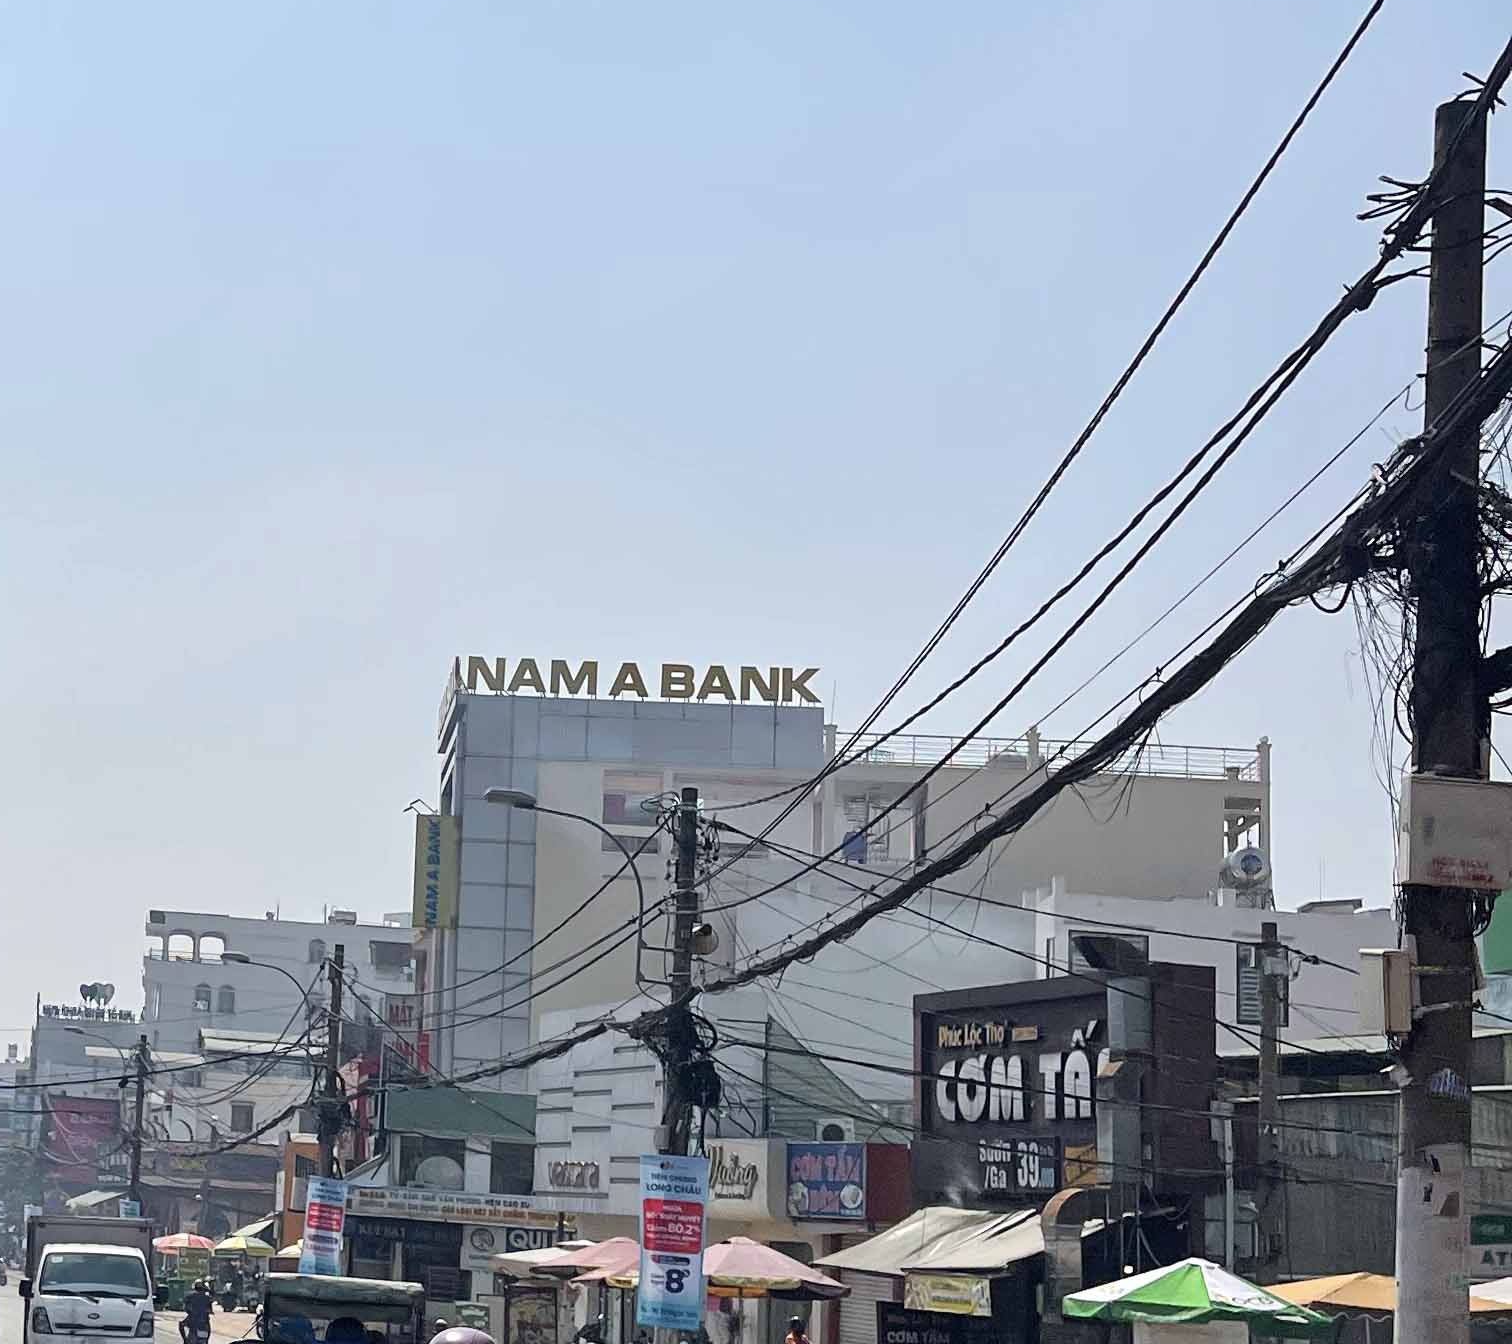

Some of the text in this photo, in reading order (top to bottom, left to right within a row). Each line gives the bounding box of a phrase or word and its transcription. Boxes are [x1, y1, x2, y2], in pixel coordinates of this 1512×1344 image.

[466, 656, 822, 703] NAM A BANK
[424, 818, 440, 928] NAM A BANK
[939, 1025, 962, 1048] Phúc
[937, 1054, 1024, 1123] CƠM
